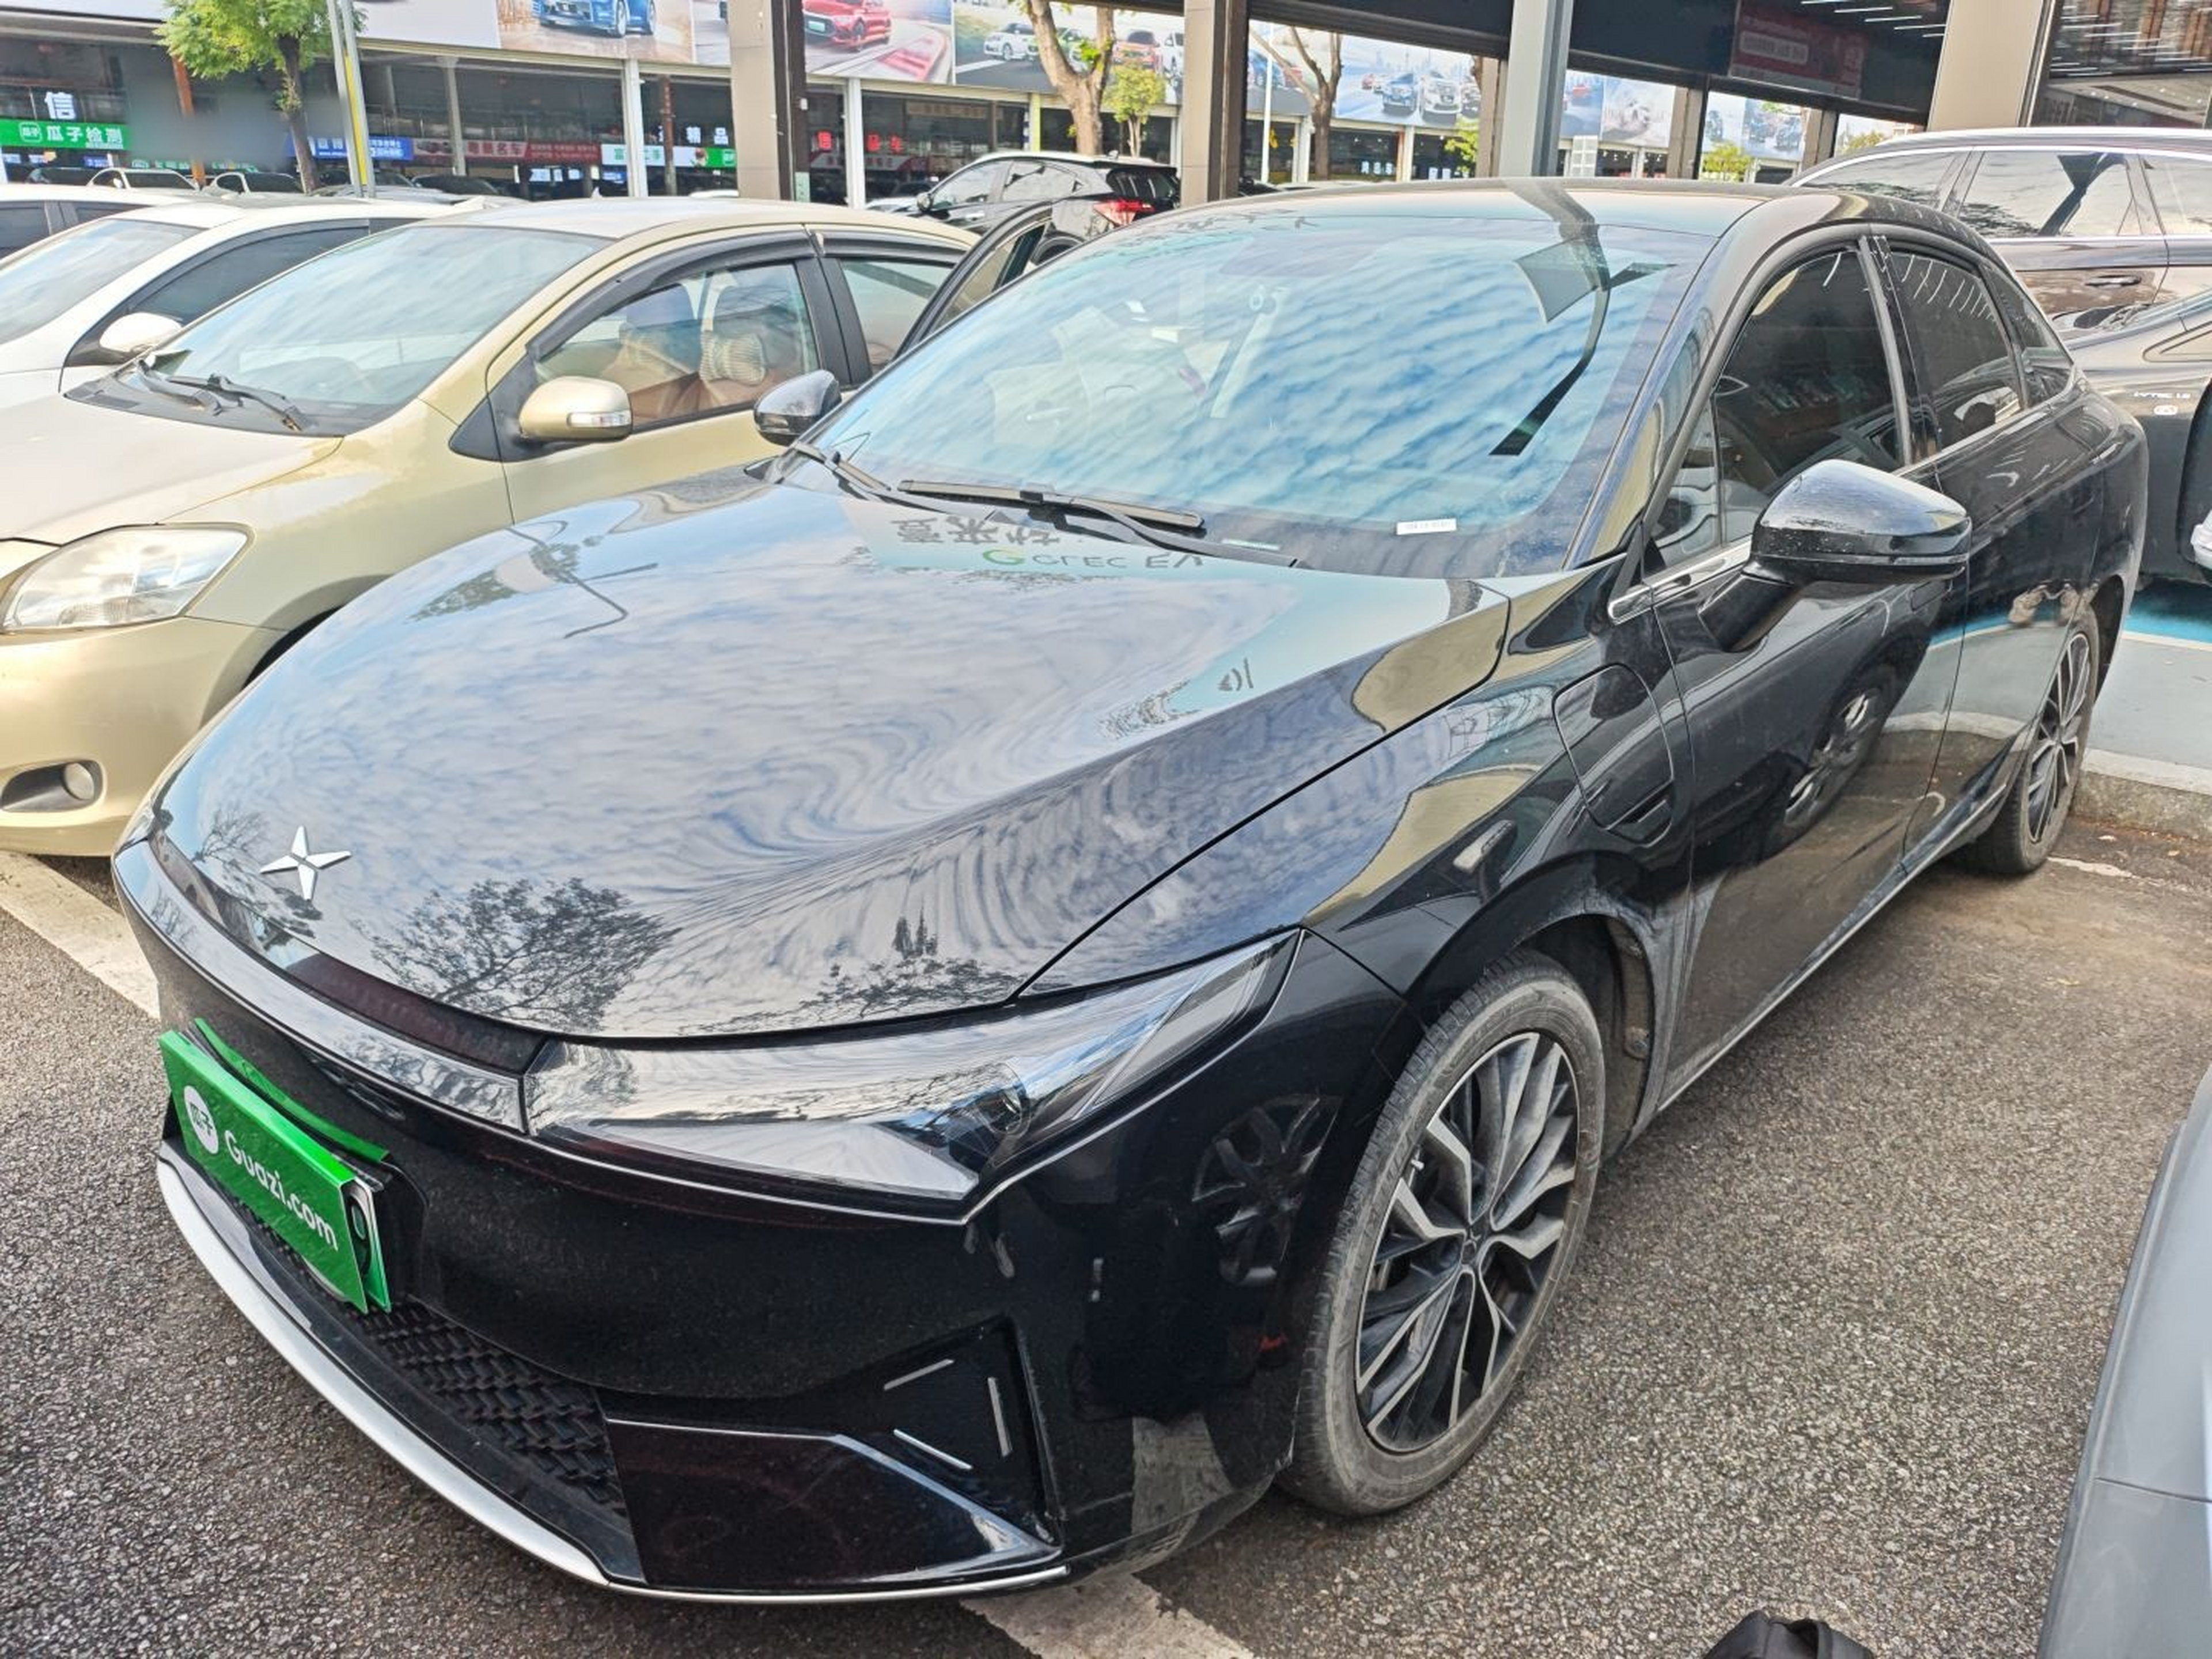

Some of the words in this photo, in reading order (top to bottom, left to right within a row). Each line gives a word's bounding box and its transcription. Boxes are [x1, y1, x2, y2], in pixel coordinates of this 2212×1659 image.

[44, 92, 76, 119] 信
[47, 126, 123, 143] 瓜子检测
[225, 1130, 338, 1251] Guazi.com
